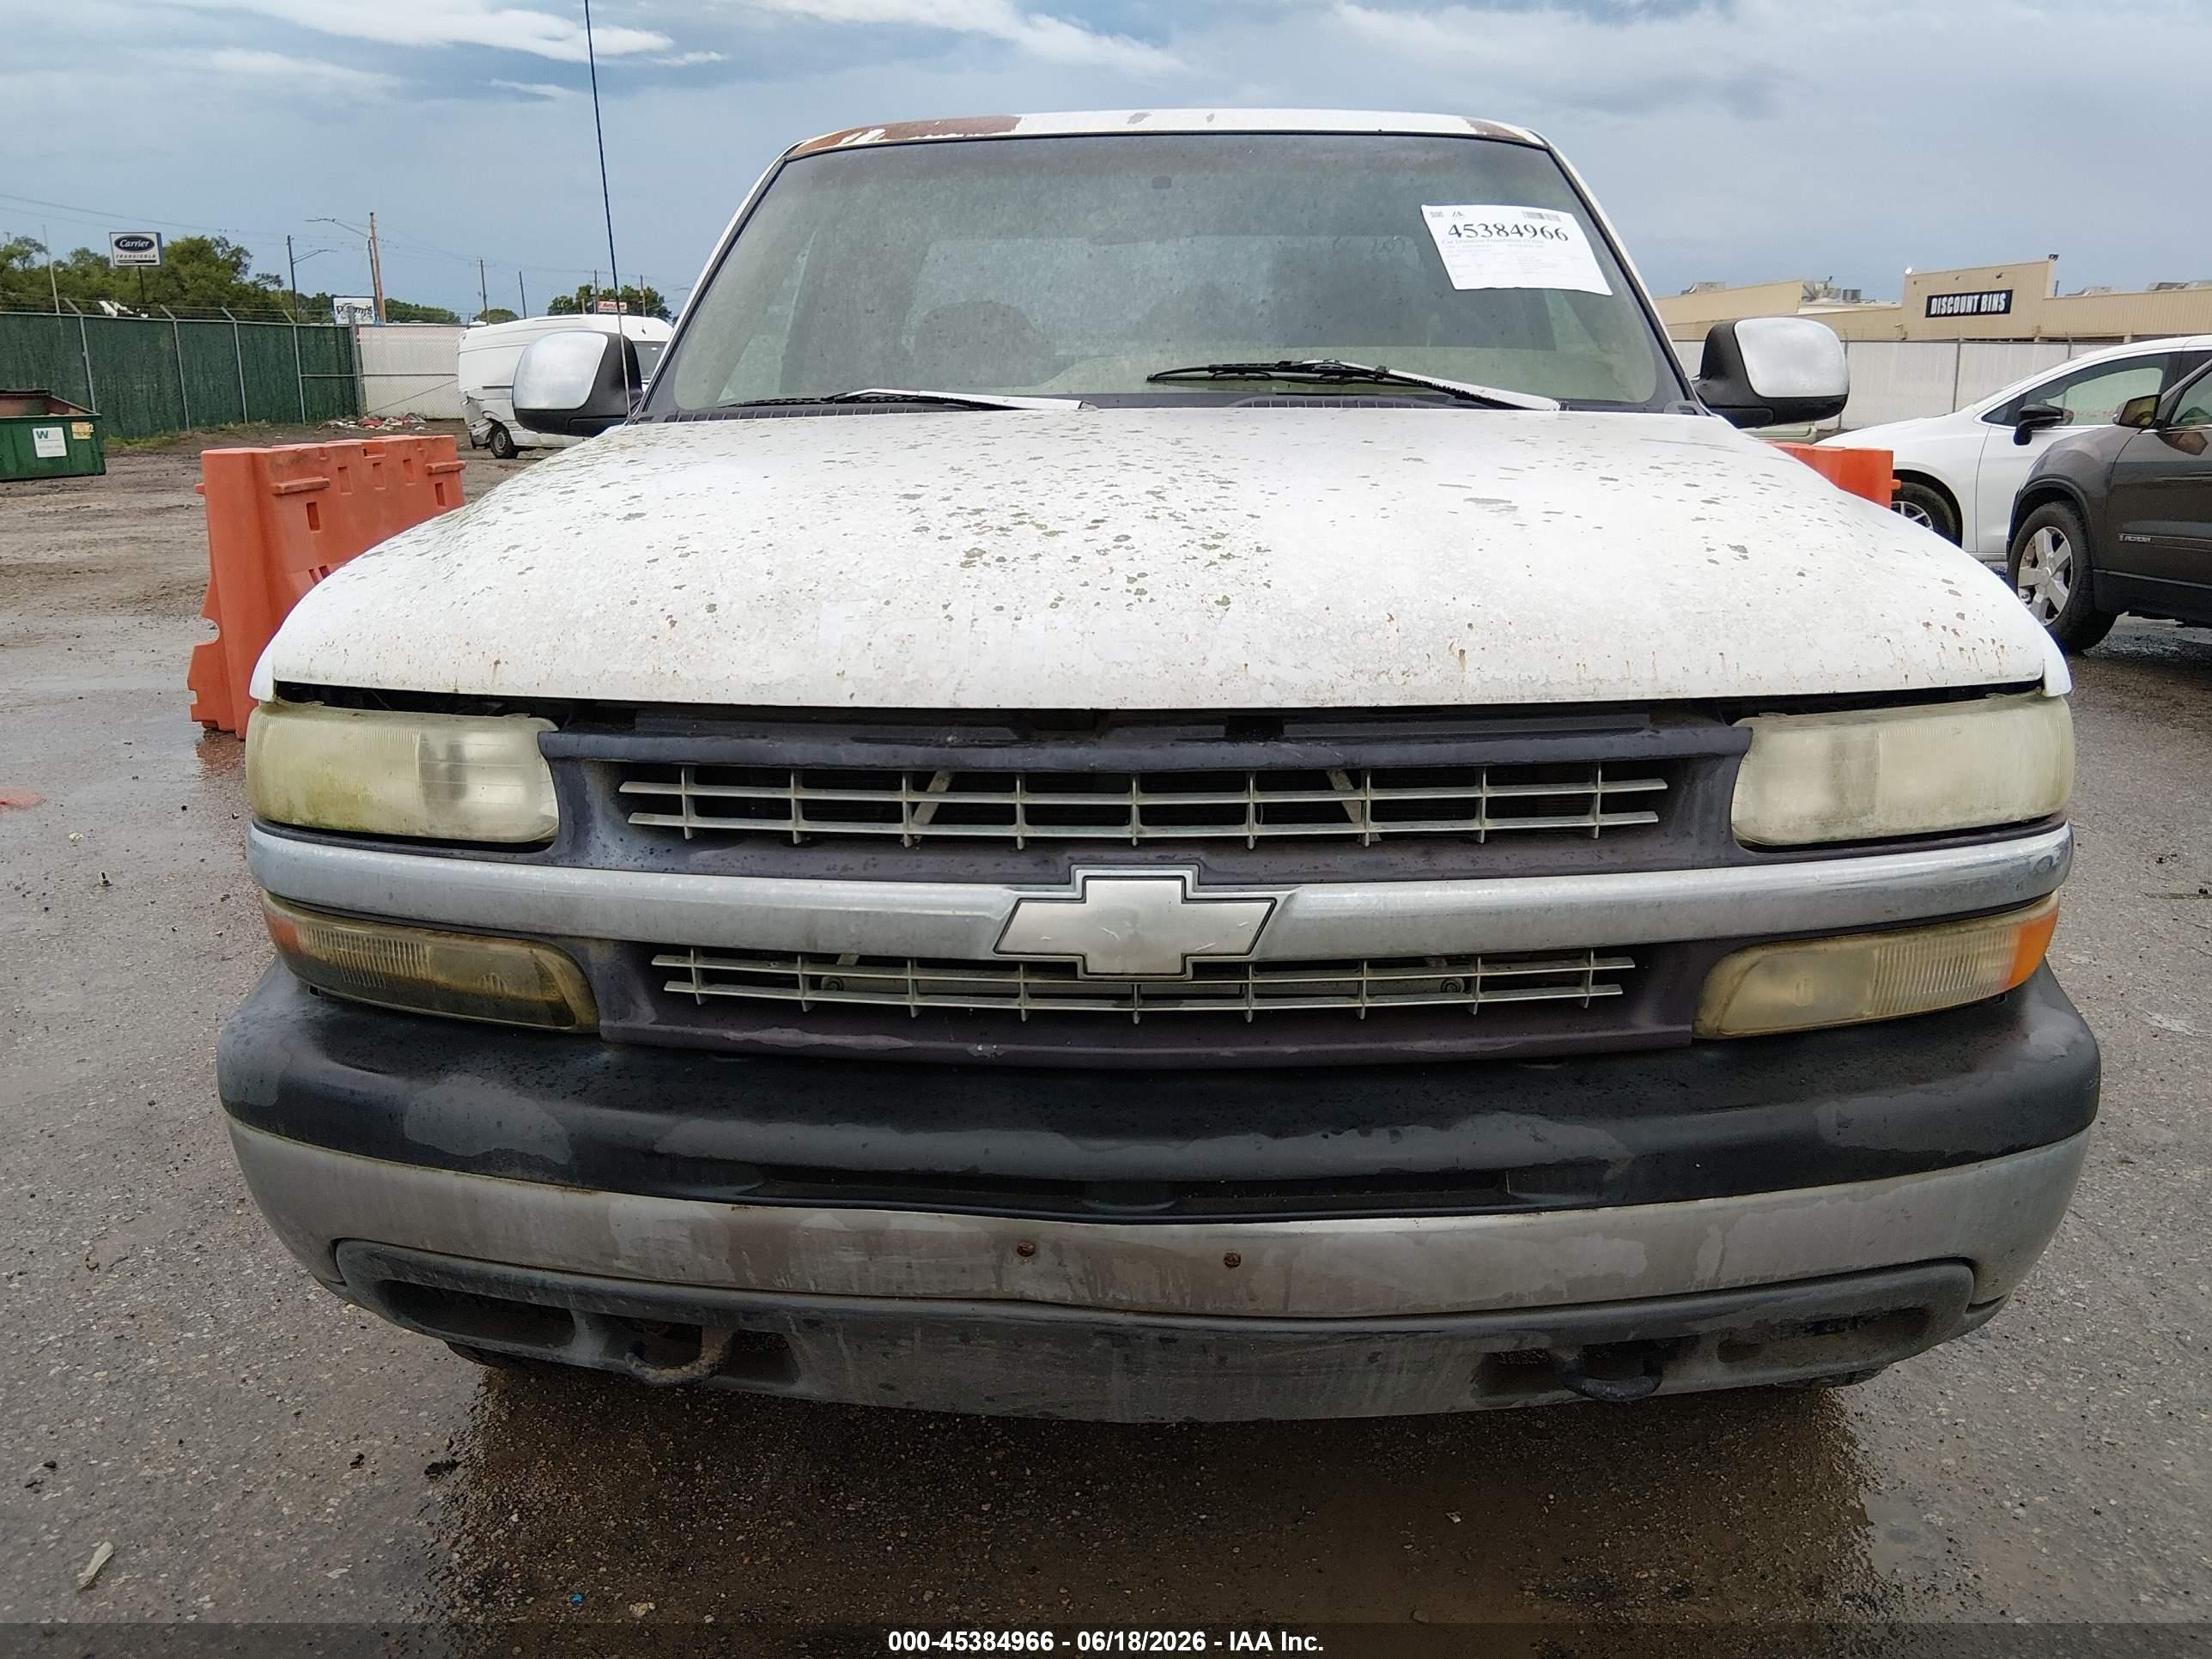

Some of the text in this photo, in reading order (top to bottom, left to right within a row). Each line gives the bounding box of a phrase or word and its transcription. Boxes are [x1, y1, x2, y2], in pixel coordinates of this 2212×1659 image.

[1449, 223, 1569, 242] 45384966
[119, 240, 150, 248] Carrier
[1929, 293, 2007, 315] DISCOUNT BINS
